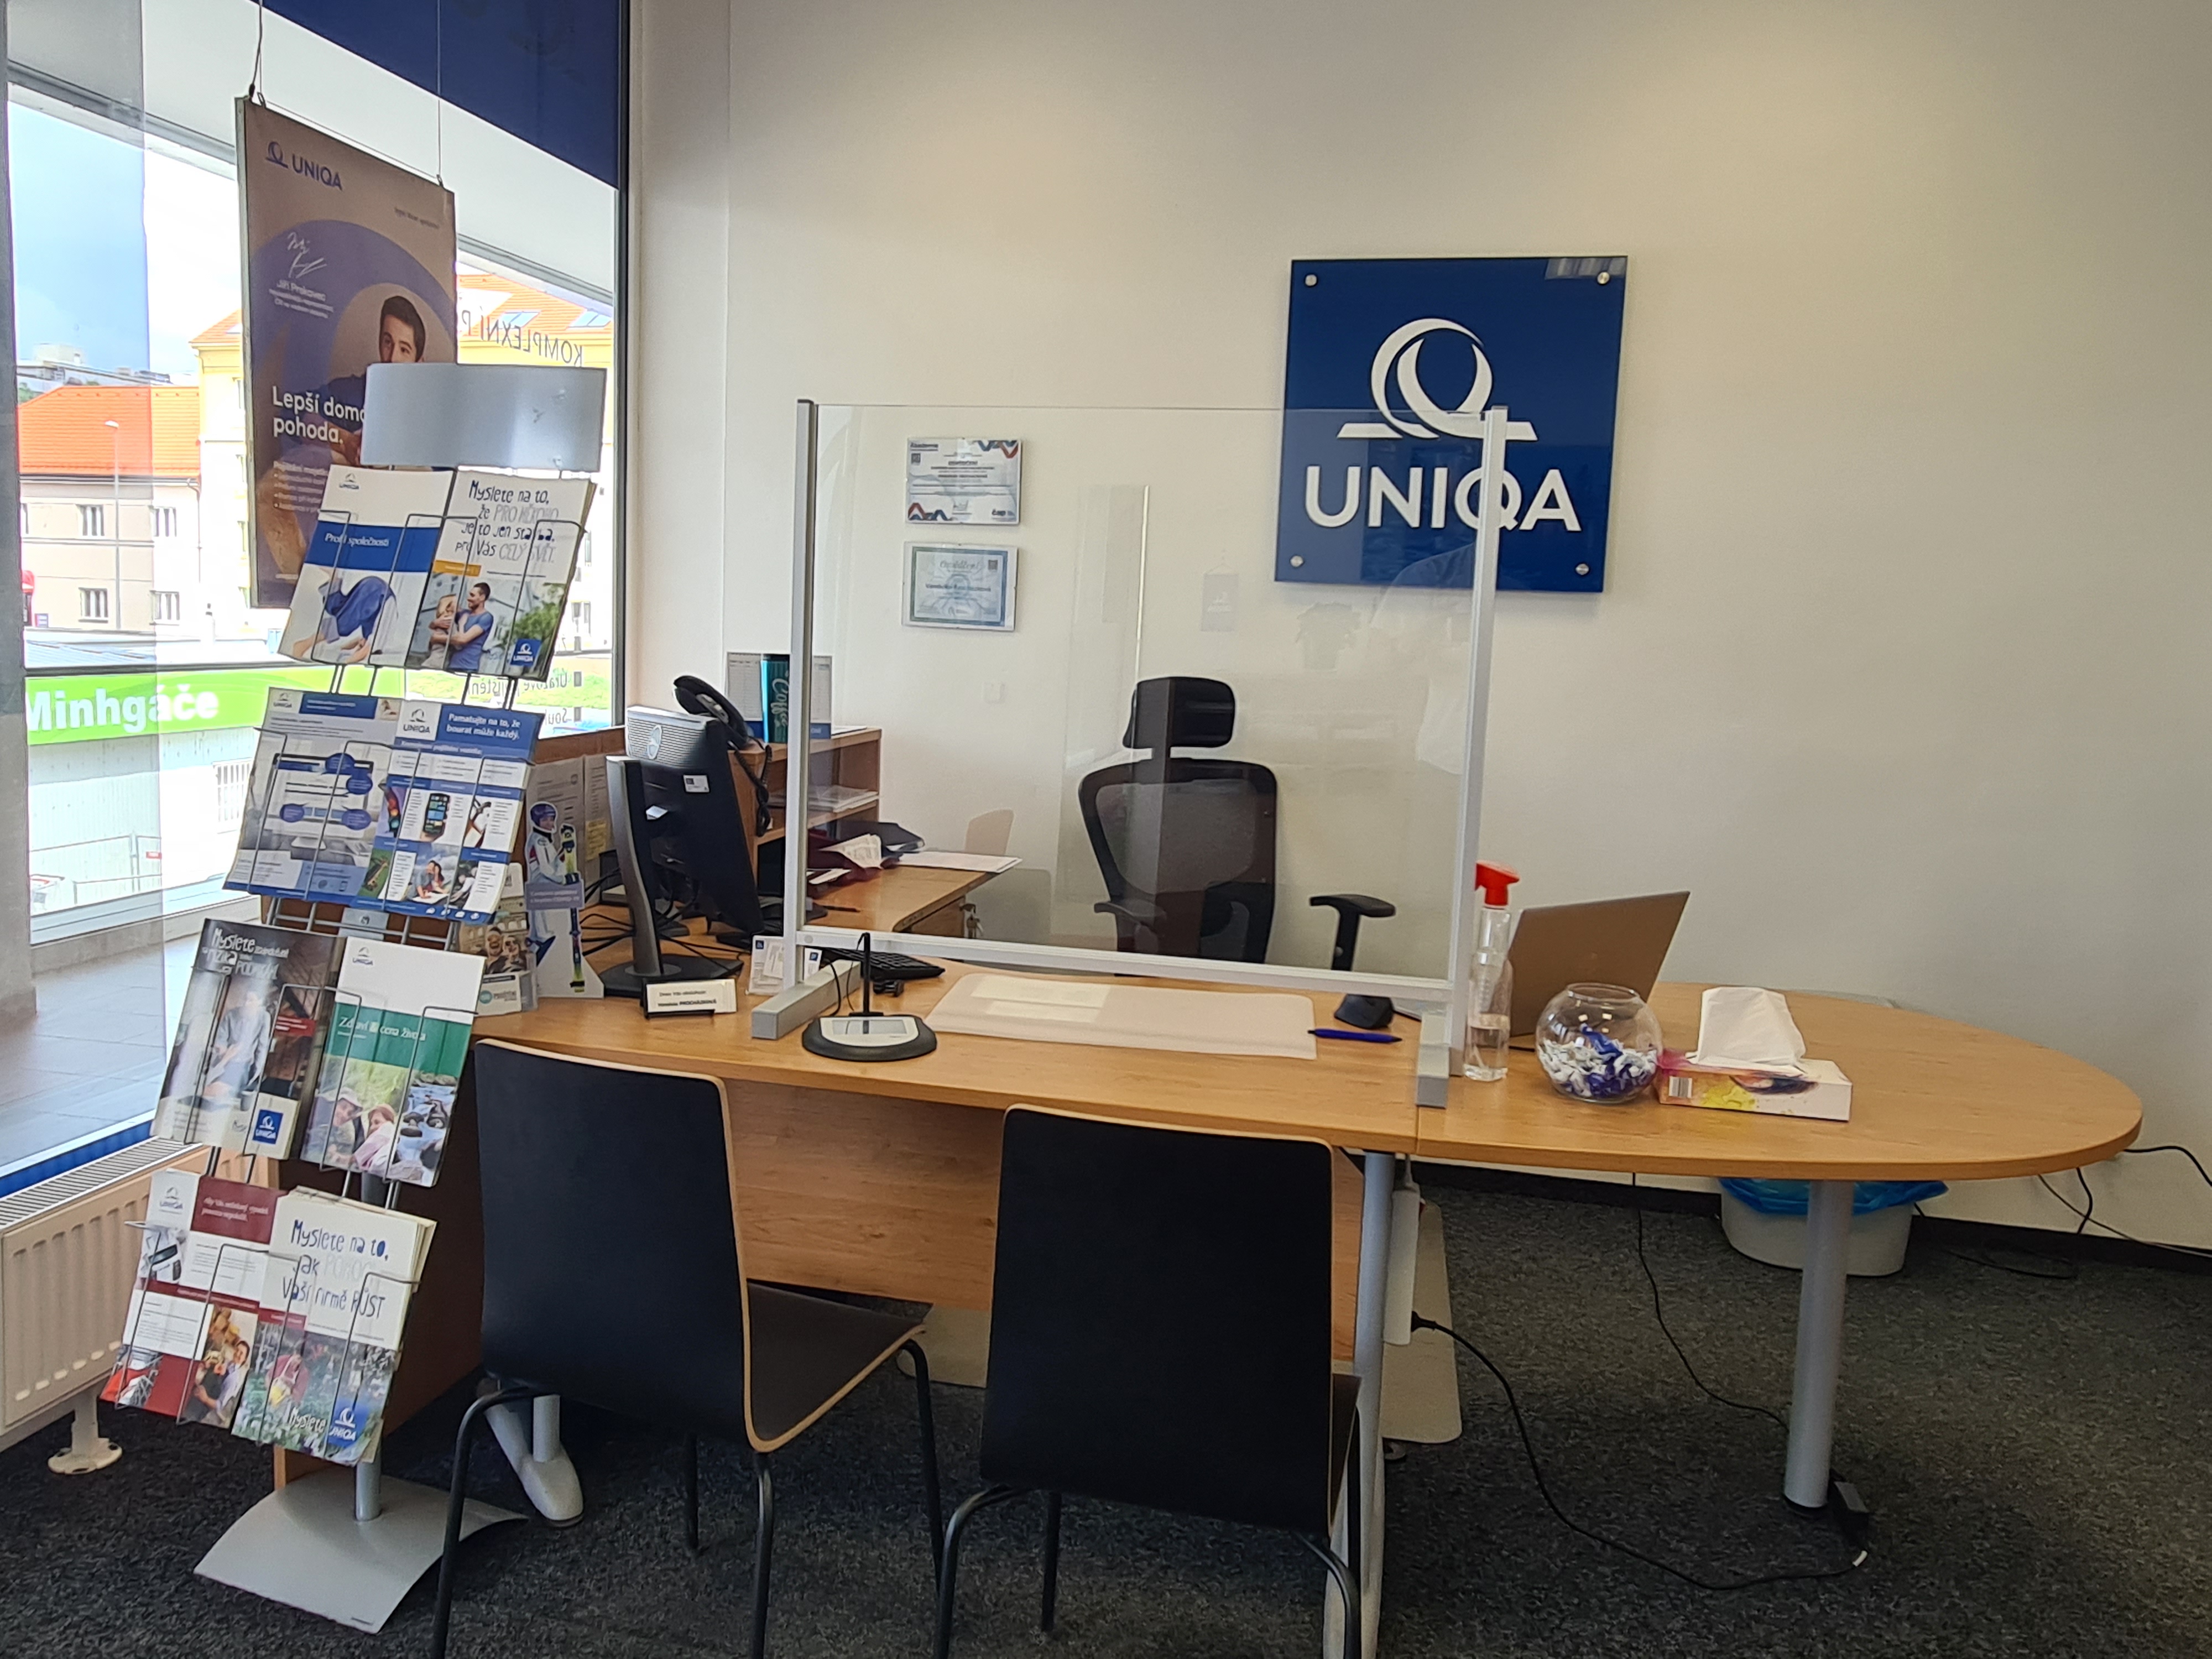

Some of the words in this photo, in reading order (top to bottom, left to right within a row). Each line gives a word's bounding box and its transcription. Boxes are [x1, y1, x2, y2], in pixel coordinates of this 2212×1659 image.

[292, 153, 343, 191] UNIQA
[273, 385, 320, 415] Lepší
[273, 416, 343, 445] pohoda.
[468, 479, 514, 503] Myslete
[518, 491, 531, 503] na
[1305, 466, 1582, 532] UNIQA
[478, 504, 491, 519] že
[478, 524, 491, 536] to
[455, 541, 471, 553] pr
[25, 684, 220, 733] Minhgáče
[403, 724, 431, 734] UNIQA
[211, 927, 256, 953] Myslete
[291, 1219, 345, 1253] Myslete
[349, 1237, 366, 1254] na
[371, 1239, 389, 1261] to,
[289, 1406, 327, 1433] Myslete
